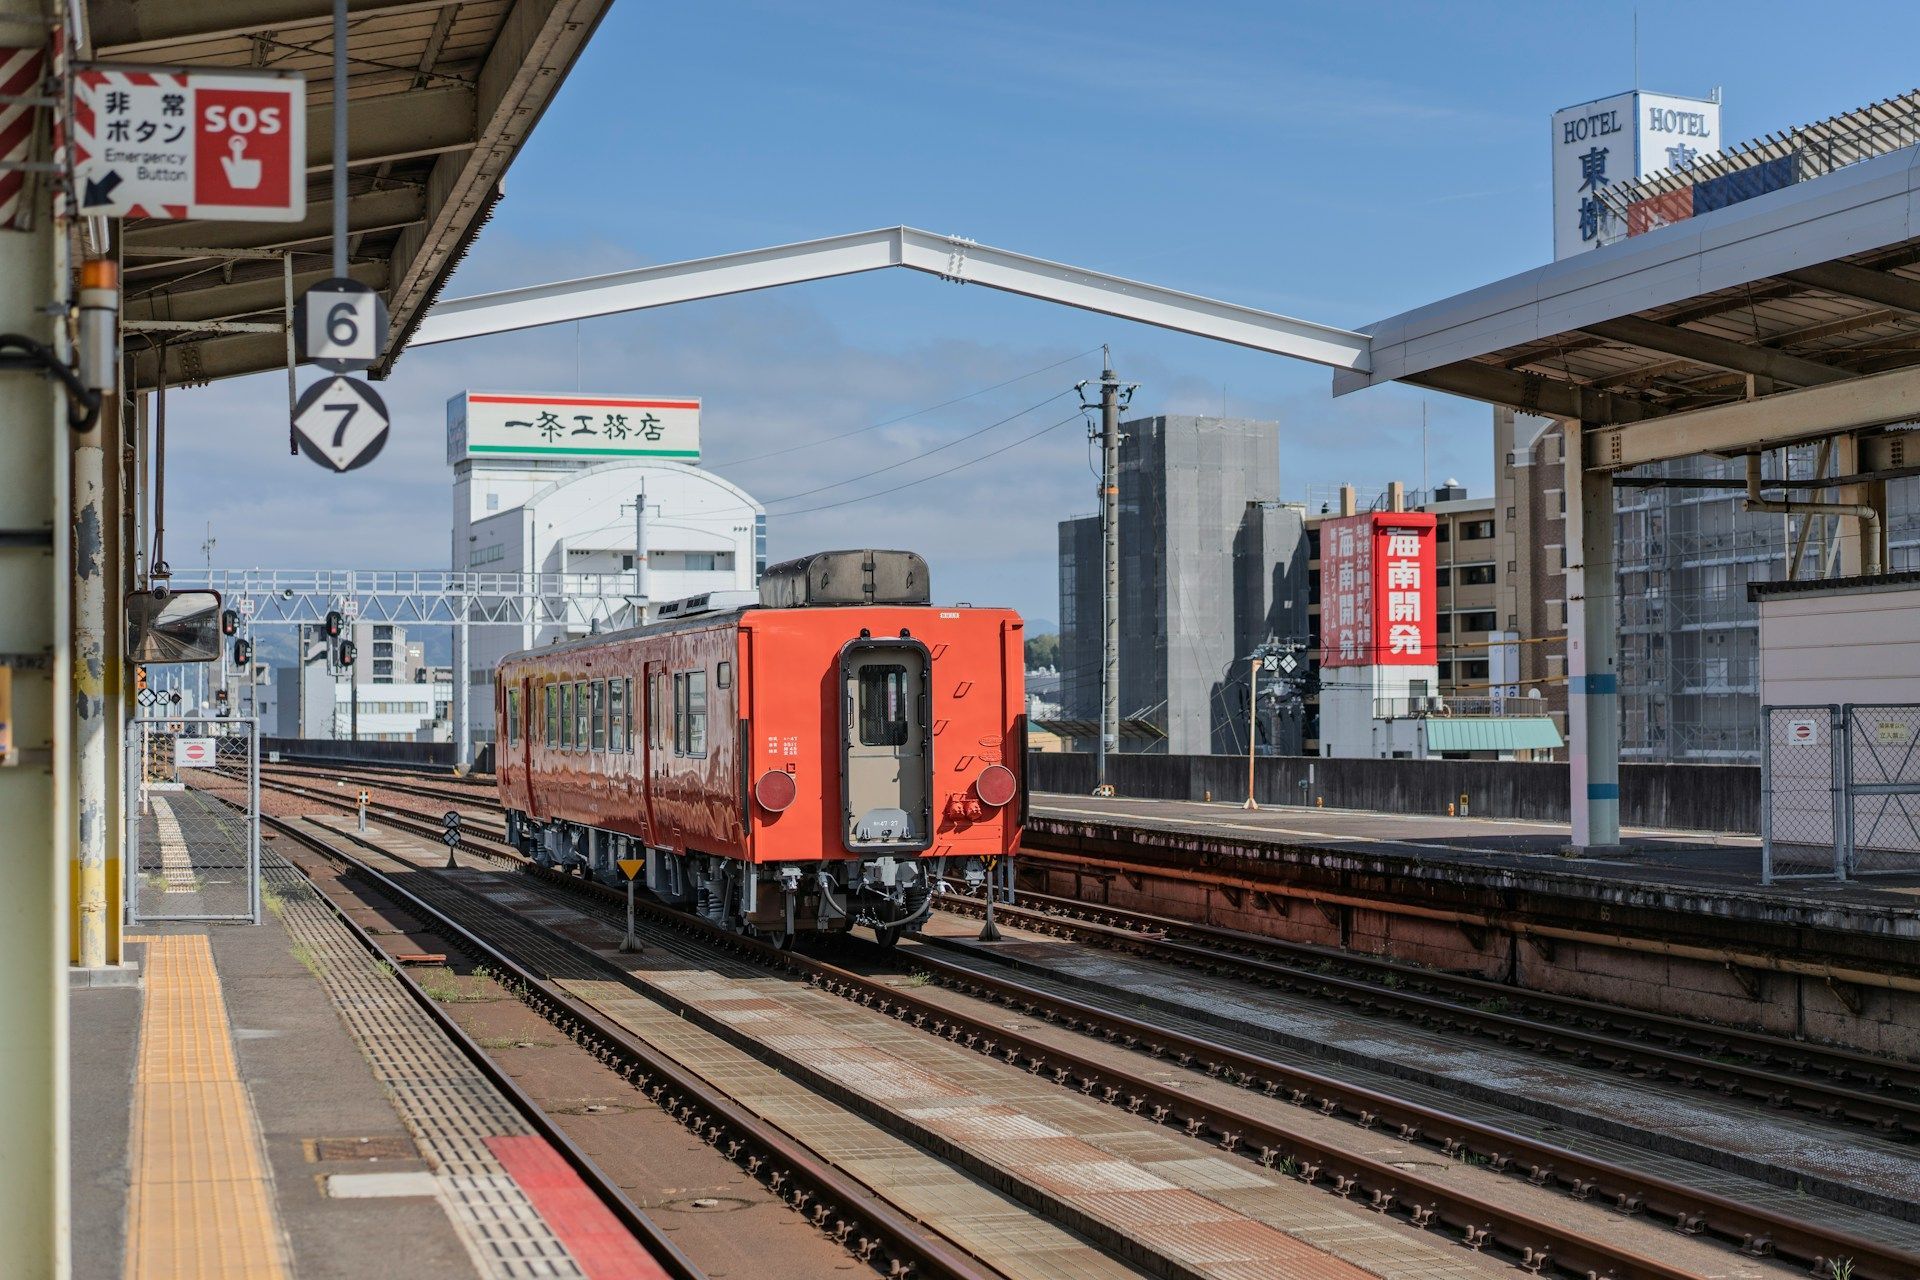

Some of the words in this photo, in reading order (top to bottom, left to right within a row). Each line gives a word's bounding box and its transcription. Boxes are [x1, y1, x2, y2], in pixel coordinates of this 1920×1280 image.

[105, 91, 186, 117] 非常
[204, 105, 282, 135] SOS
[106, 119, 186, 143] ボタン
[1563, 109, 1622, 144] HOTEL
[1649, 107, 1711, 138] HOTEL
[104, 148, 188, 165] Emergency
[137, 166, 188, 182] Button
[327, 302, 358, 347] 6
[323, 403, 359, 448] 7
[505, 411, 665, 444] 一条工務店
[1338, 526, 1355, 661] 海南開発
[1386, 527, 1422, 655] 海南開発
